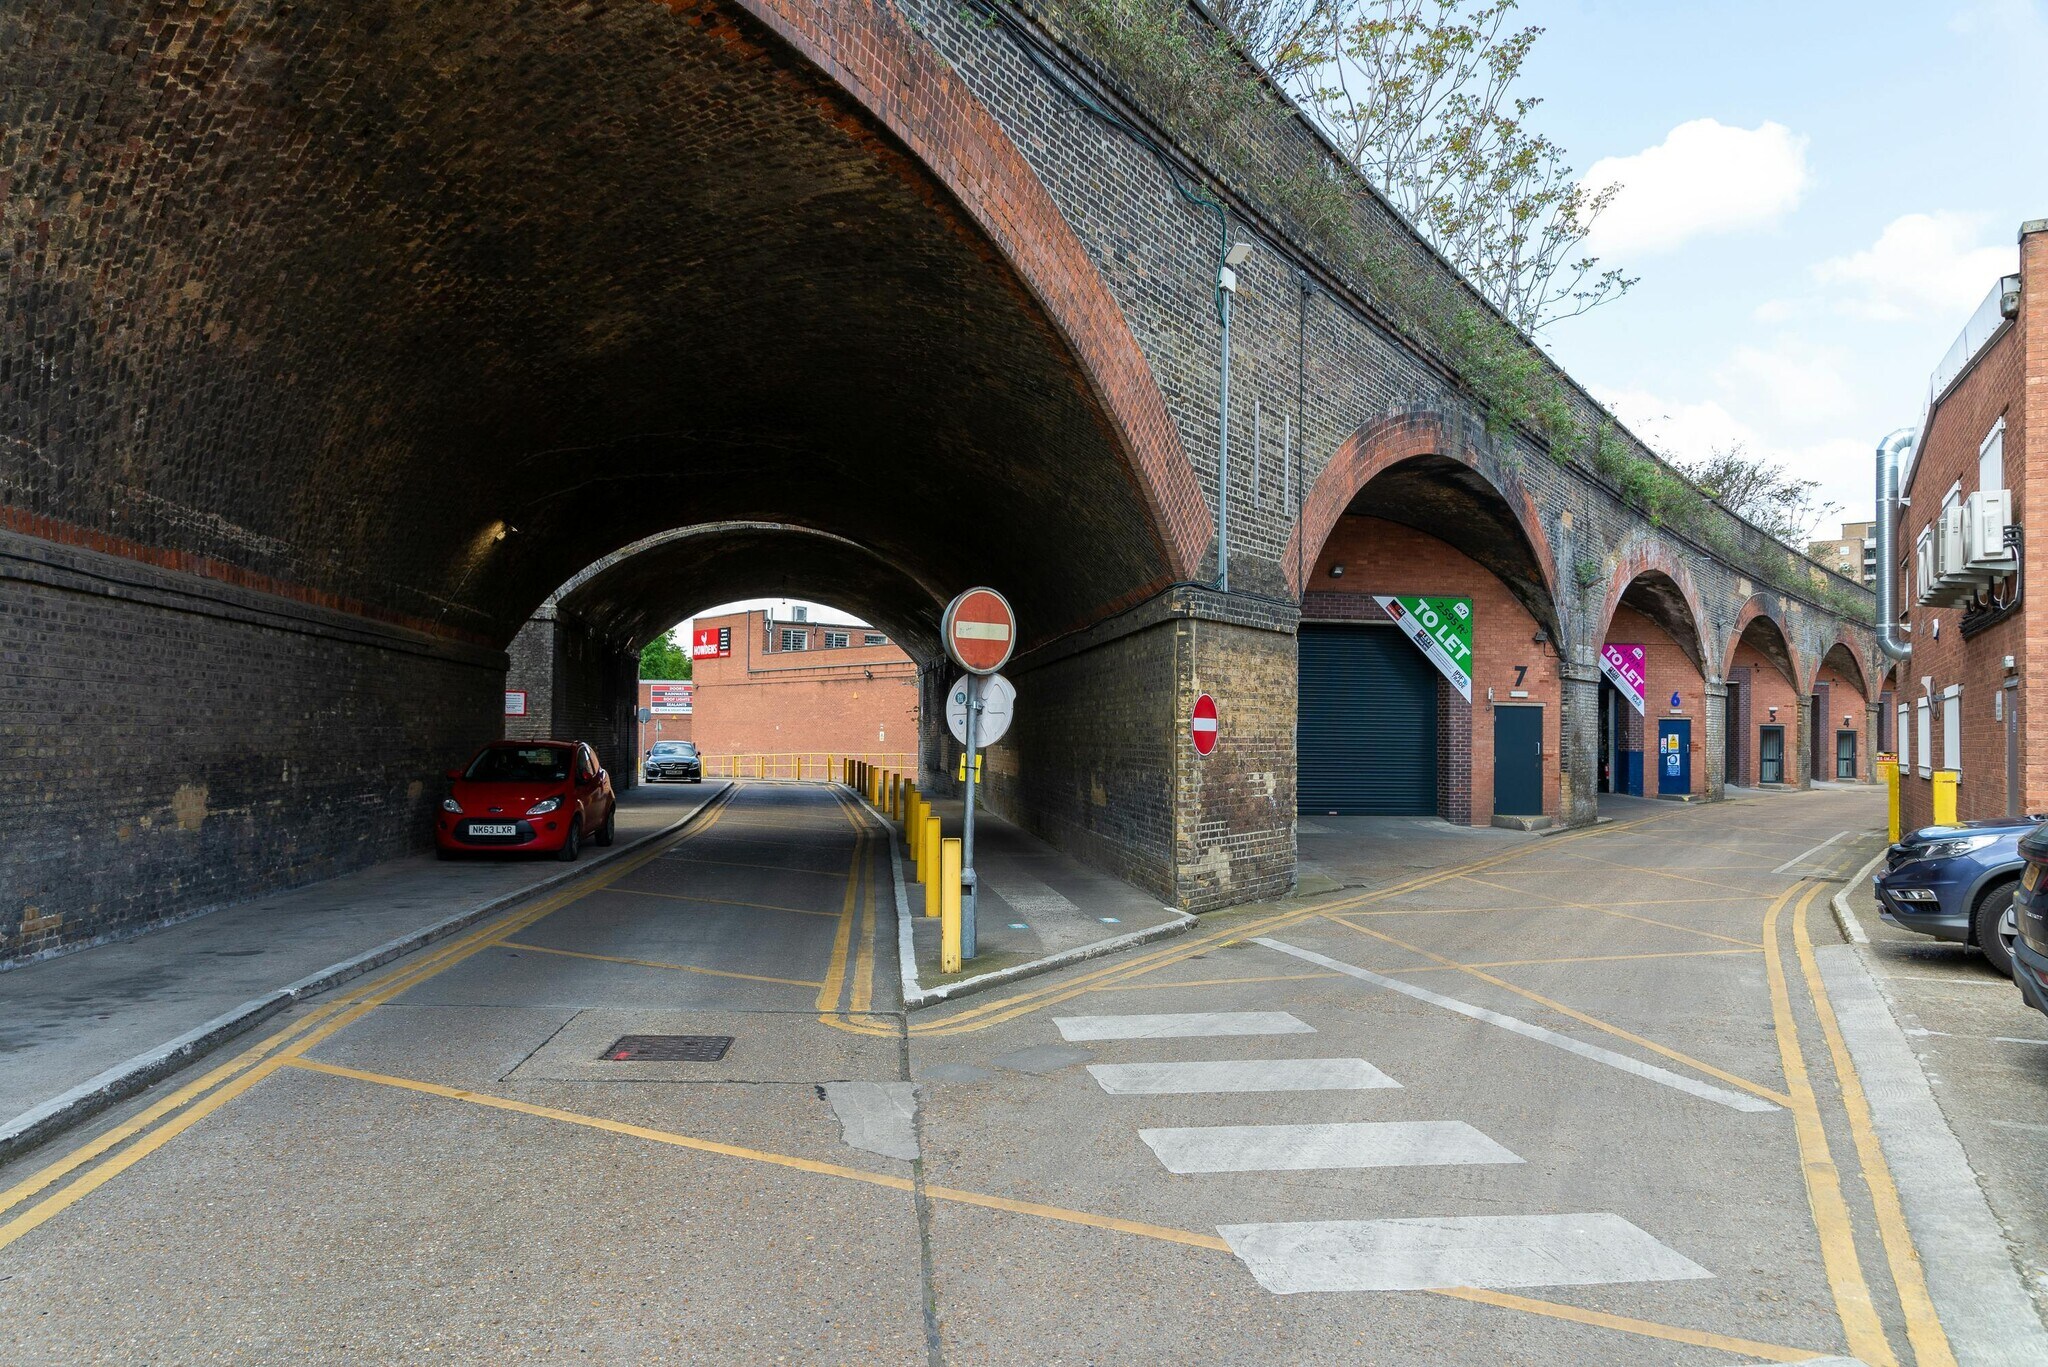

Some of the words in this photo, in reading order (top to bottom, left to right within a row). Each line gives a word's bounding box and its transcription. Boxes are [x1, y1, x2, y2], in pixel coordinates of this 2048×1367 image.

[1414, 598, 1438, 627] TO
[1435, 625, 1471, 660] LET
[694, 644, 717, 655] HOWDENS
[1606, 645, 1623, 665] TO
[1620, 663, 1644, 688] LET
[1515, 666, 1528, 686] 7
[1671, 692, 1680, 707] 6
[1769, 709, 1776, 722] 5
[1843, 718, 1849, 727] 4
